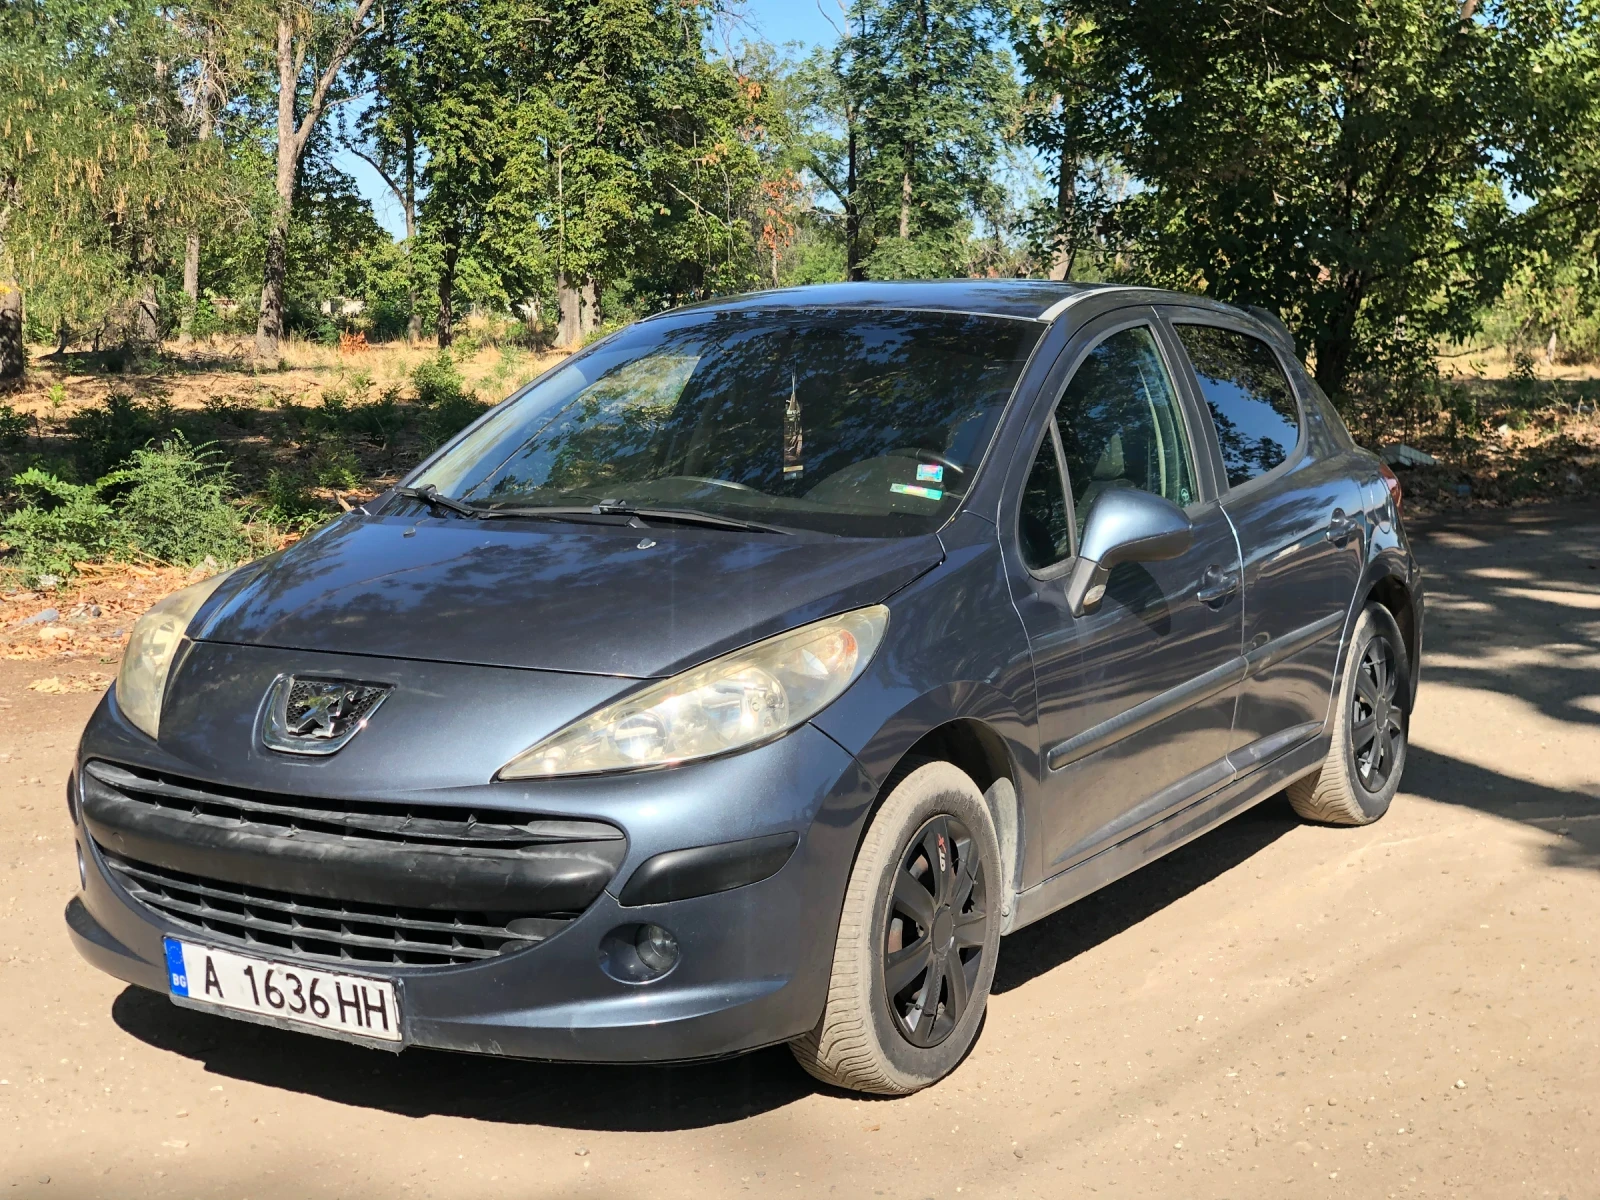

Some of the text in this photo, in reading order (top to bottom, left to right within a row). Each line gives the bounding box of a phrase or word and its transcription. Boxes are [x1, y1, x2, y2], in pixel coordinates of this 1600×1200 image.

[172, 973, 187, 989] BG
[205, 955, 389, 1031] A 1636 HH
